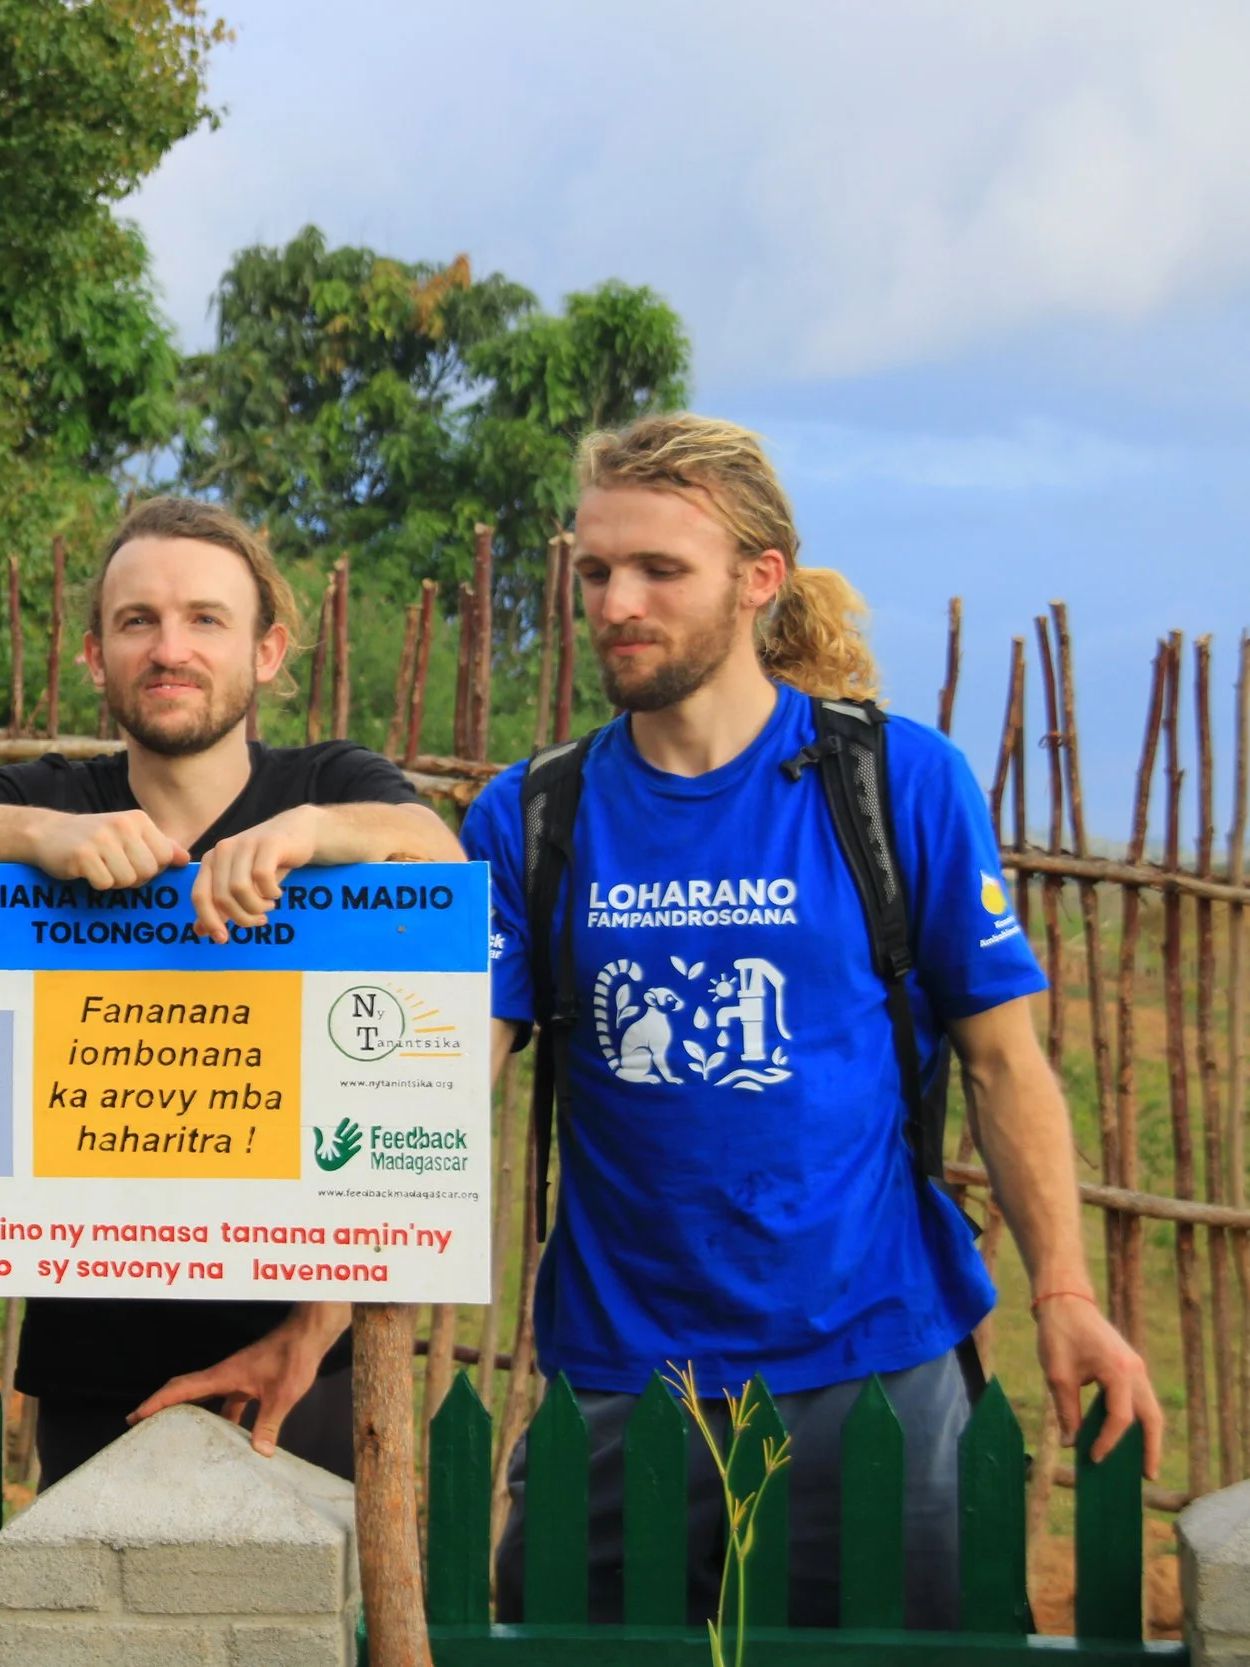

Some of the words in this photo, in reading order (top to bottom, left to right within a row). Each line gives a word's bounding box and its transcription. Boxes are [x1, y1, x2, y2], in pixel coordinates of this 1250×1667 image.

[341, 886, 454, 910] MADIO
[589, 878, 798, 910] LOHARANO
[587, 908, 798, 928] FAMPANDROSOANA
[81, 996, 250, 1025] Fananana
[69, 1039, 262, 1067] iombonana
[49, 1081, 88, 1109] ka
[100, 1089, 197, 1116] arovy
[208, 1083, 283, 1110] mba
[339, 1079, 454, 1090] www.nytanintsikaorg
[77, 1125, 232, 1153] haharitra
[370, 1125, 468, 1149] Feedback
[371, 1152, 468, 1175] Madagascar
[317, 1187, 480, 1202] www.feedbackmadagascar.org
[50, 1223, 84, 1248] ny
[92, 1224, 208, 1243] manasa
[220, 1221, 325, 1245] tanana
[333, 1222, 452, 1254] amin'ny
[37, 1258, 69, 1284] sy
[76, 1259, 181, 1286] savony
[188, 1261, 223, 1280] na
[253, 1258, 388, 1282] lavenona
